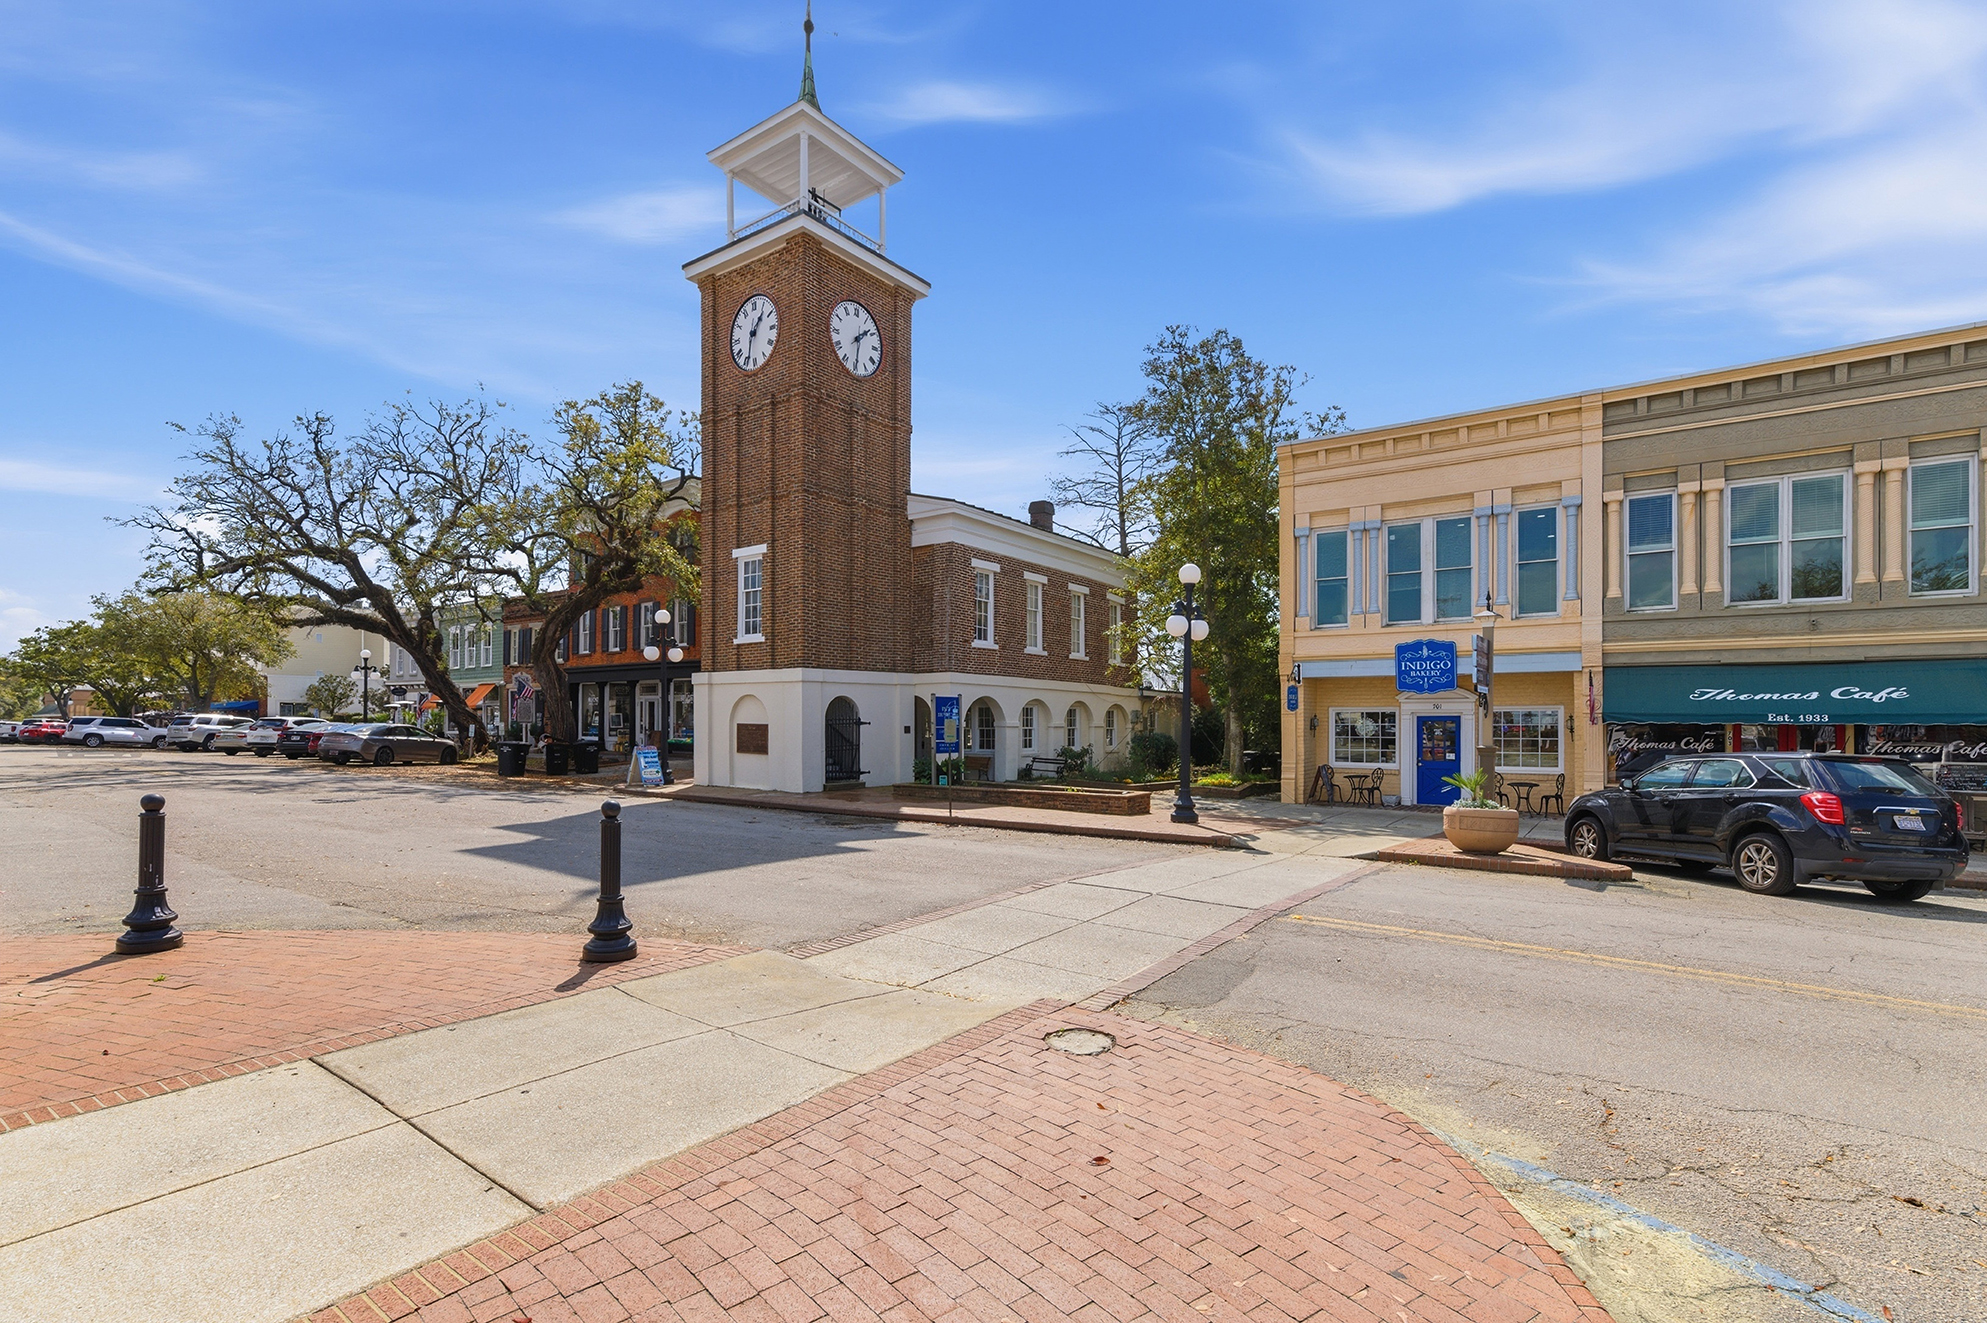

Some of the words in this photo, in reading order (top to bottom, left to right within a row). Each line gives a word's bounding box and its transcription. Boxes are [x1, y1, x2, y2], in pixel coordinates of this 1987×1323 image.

[1401, 660, 1451, 670] INDIGO
[1689, 688, 1820, 701] Thomas
[1830, 686, 1910, 703] Café
[1767, 713, 1794, 722] Est.
[1798, 714, 1829, 722] 1933
[1616, 736, 1677, 752] Thomas
[1680, 736, 1715, 753] Café
[1865, 740, 1942, 755] Thomas
